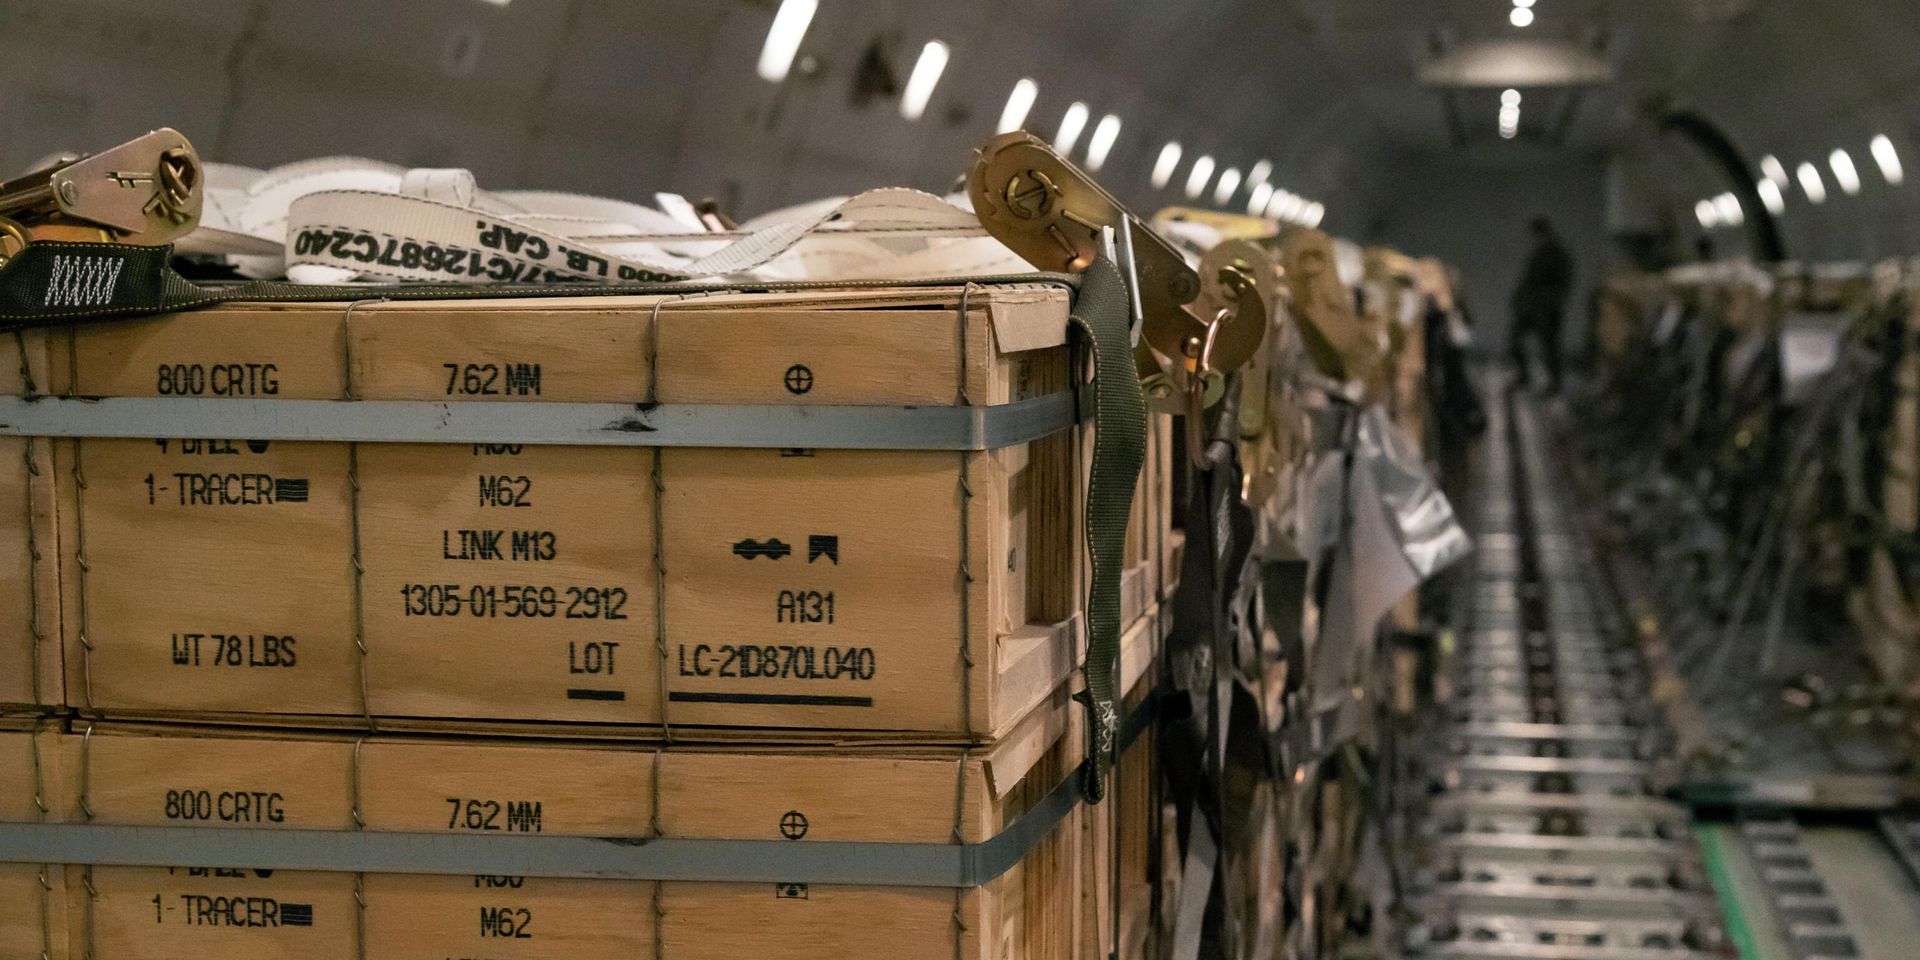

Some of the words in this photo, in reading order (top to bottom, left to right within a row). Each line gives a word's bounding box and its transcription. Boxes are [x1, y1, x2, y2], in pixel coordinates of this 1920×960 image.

[476, 220, 550, 260] CAP.
[558, 244, 609, 277] LB.
[157, 364, 204, 396] 800
[210, 363, 279, 397] CRTG
[443, 363, 499, 396] 7.62
[505, 363, 541, 396] MM
[173, 473, 273, 506] TRACER
[479, 475, 532, 508] M62
[443, 529, 504, 561] LINK
[511, 530, 557, 562] M13
[400, 583, 628, 620] 1305-01-569-2912
[777, 590, 834, 624] A131
[172, 634, 205, 667] WT
[210, 634, 243, 667] 78
[249, 635, 296, 668] LBS
[569, 642, 620, 675] LOT
[165, 790, 212, 821] 800
[217, 791, 284, 824] CRTG
[446, 798, 501, 830] 7.62
[507, 801, 542, 833] MM
[180, 894, 279, 928] TRACER
[480, 906, 532, 939] M62
